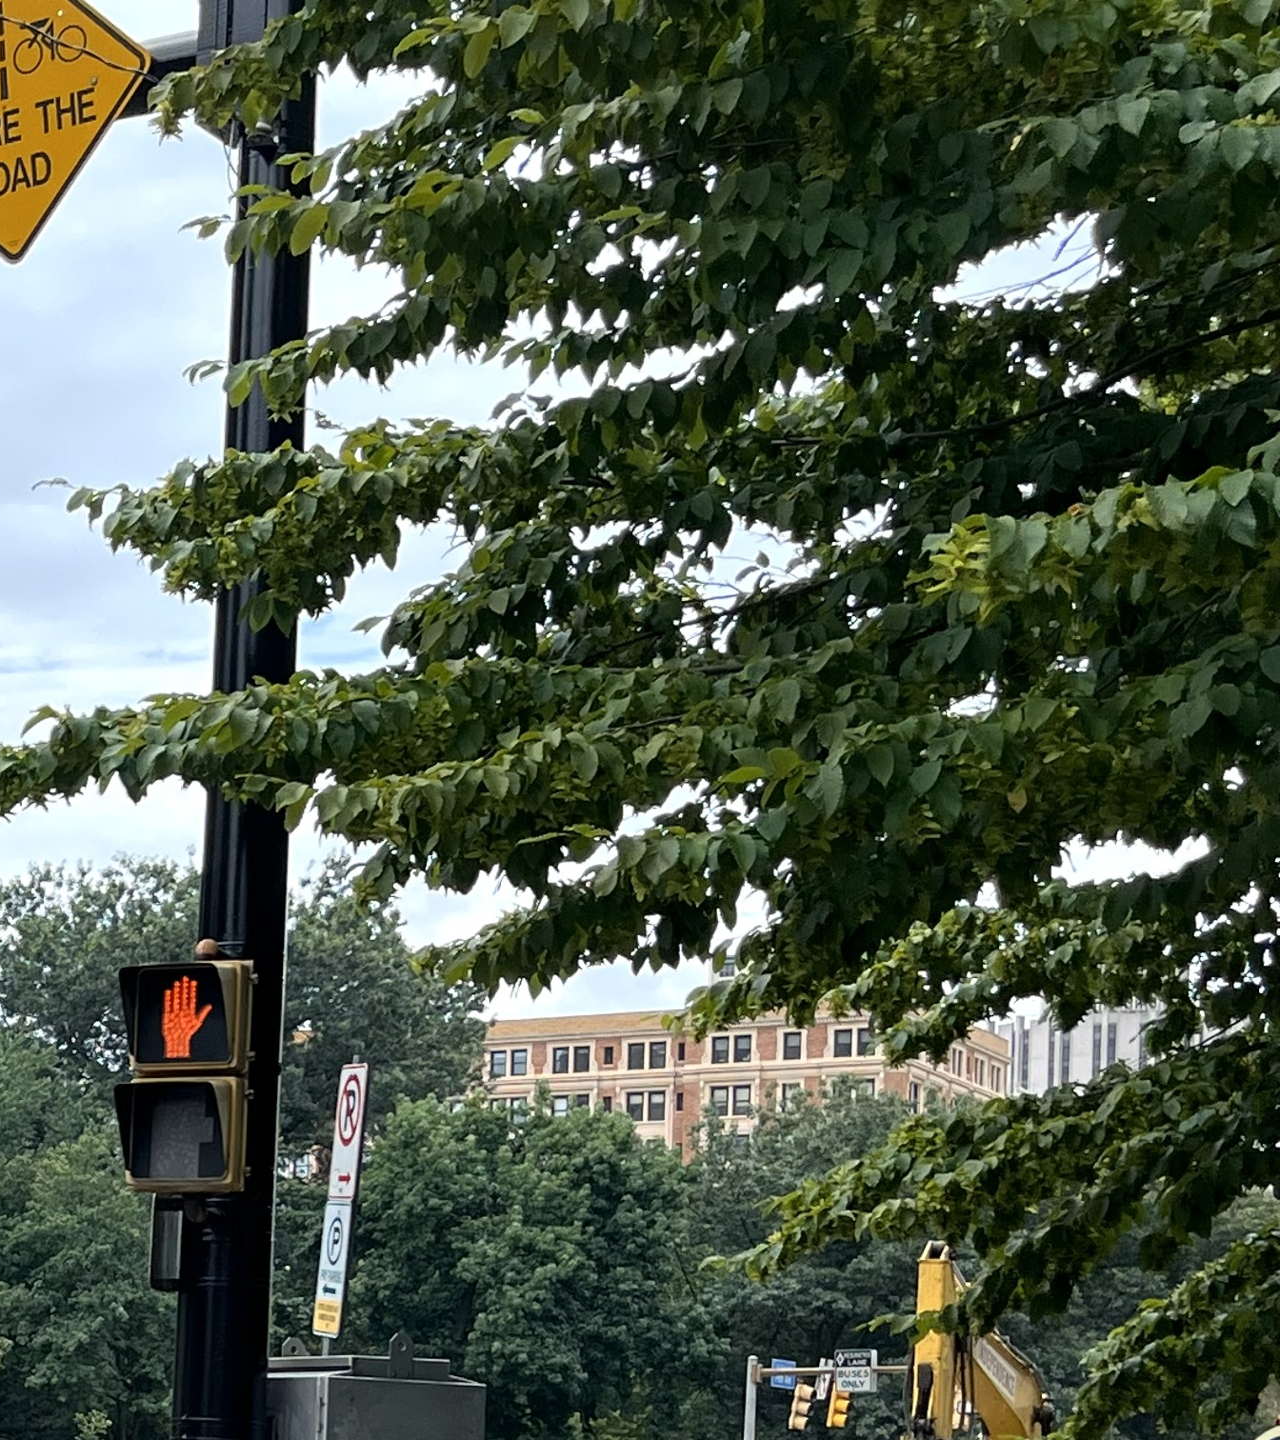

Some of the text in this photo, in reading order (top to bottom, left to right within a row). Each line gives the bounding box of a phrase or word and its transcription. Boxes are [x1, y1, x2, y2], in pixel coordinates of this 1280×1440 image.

[34, 88, 99, 132] THE
[838, 1370, 869, 1378] BUSES
[841, 1380, 865, 1388] ONLY
